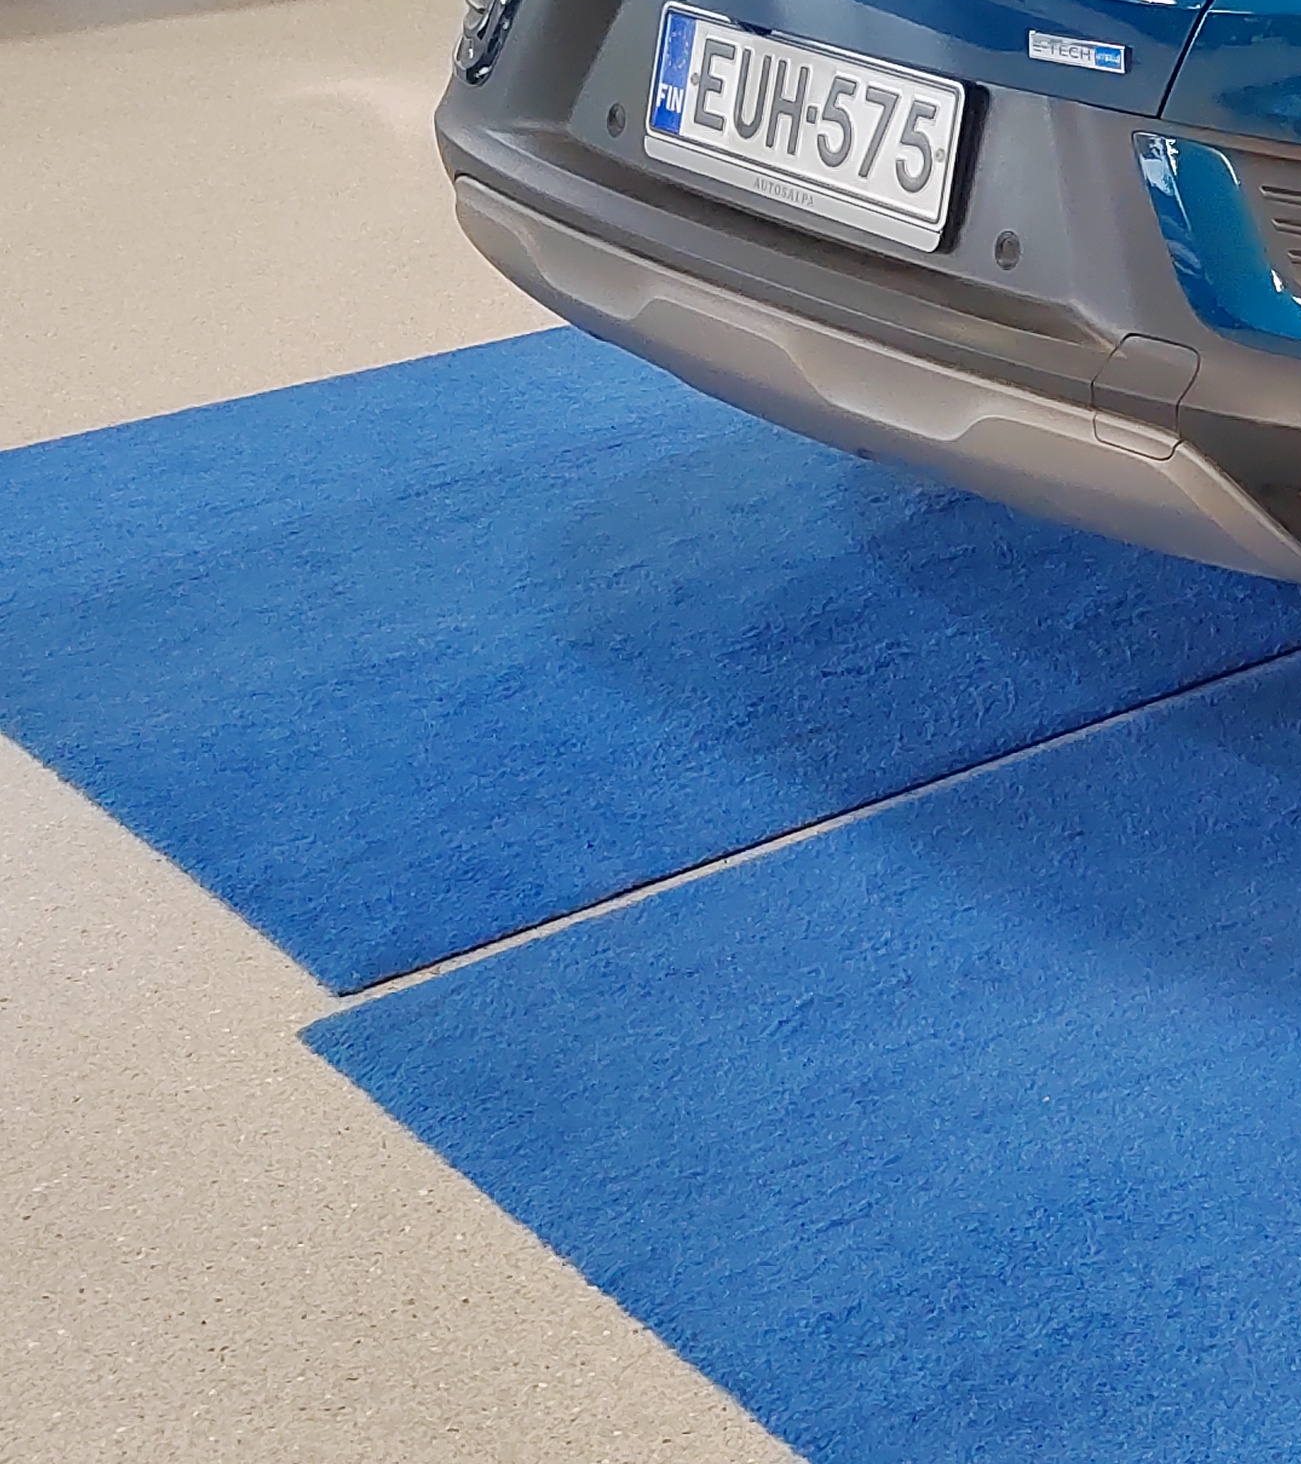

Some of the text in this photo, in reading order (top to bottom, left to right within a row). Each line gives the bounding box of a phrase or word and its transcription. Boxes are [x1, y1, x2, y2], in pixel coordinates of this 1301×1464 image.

[655, 37, 938, 194] FIN EUH-575
[754, 176, 816, 208] AUTOSALPA
